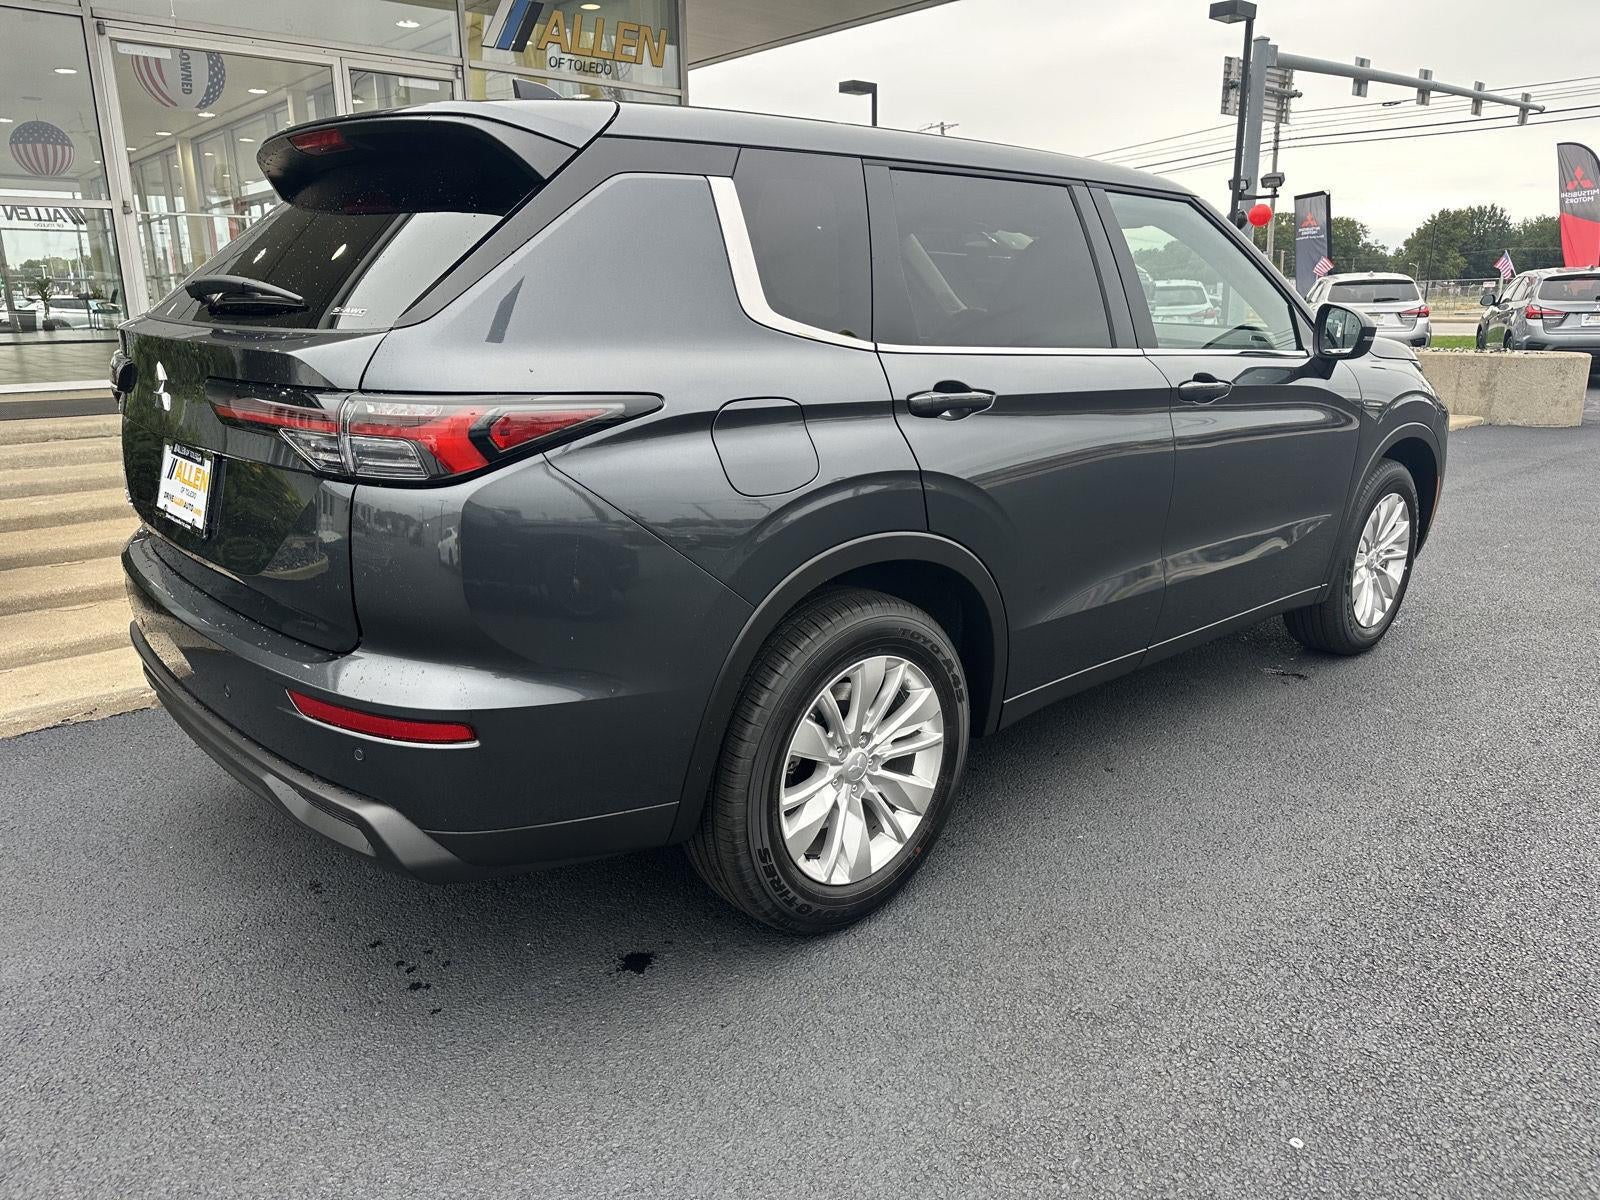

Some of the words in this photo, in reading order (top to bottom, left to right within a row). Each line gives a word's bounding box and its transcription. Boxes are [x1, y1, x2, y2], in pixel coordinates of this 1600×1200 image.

[537, 10, 667, 68] ALLEN
[549, 56, 566, 69] OF
[567, 58, 612, 76] TOLEDO
[175, 461, 209, 492] ALLEN
[898, 627, 941, 655] TOYO
[756, 847, 799, 909] TIRES
